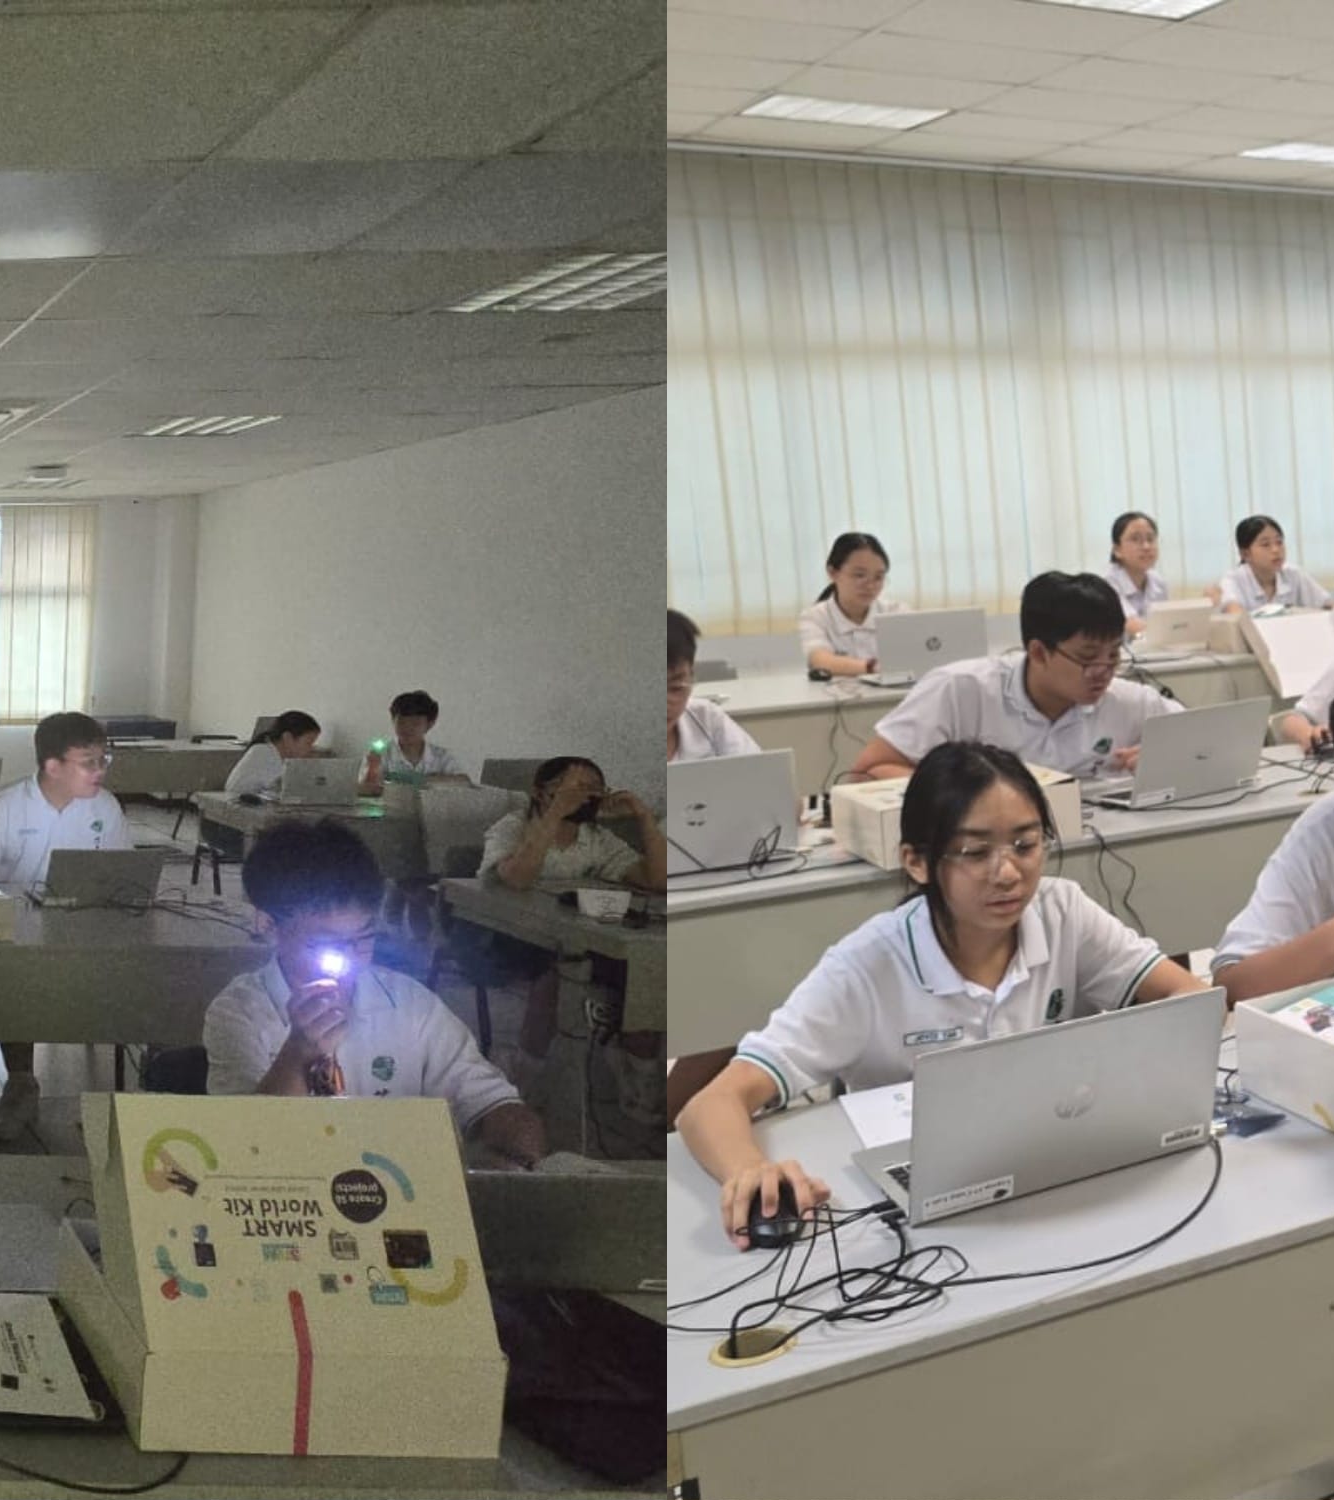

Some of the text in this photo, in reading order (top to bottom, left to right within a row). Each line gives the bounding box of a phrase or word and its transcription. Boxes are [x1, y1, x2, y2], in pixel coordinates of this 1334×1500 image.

[222, 1198, 323, 1217] World Kit
[242, 1219, 317, 1238] SMART
